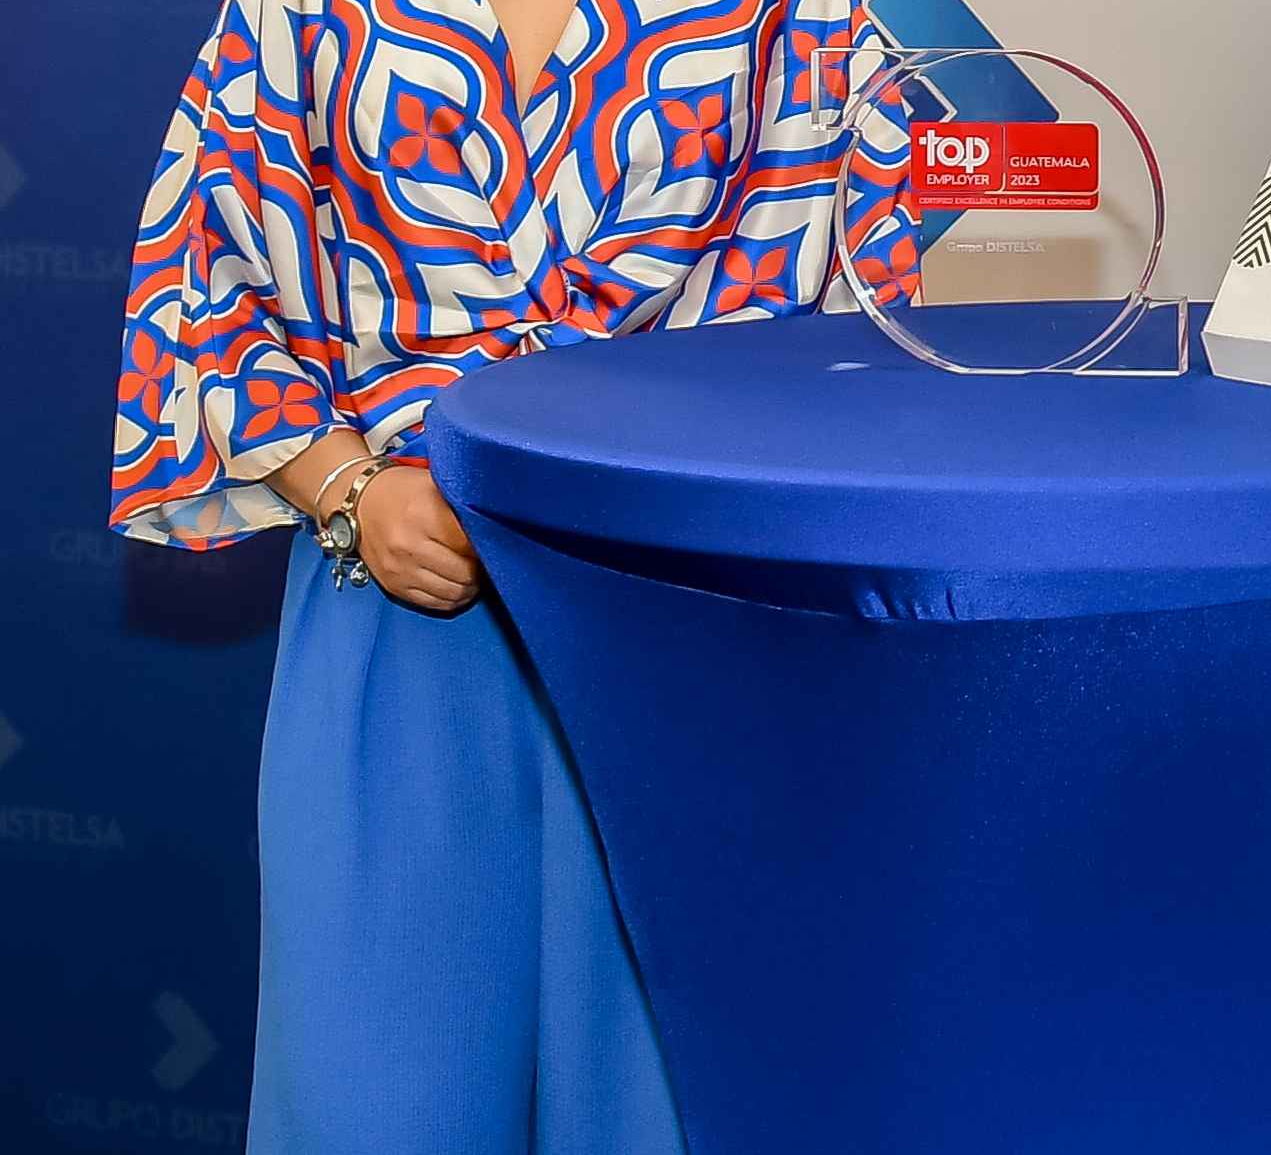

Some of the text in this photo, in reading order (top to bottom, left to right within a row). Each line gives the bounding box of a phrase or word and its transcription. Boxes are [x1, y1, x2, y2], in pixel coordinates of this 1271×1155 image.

[919, 129, 990, 173] top
[1009, 156, 1091, 169] GUATEMALA
[926, 173, 990, 186] EMPLOYER
[1009, 174, 1041, 186] 2023
